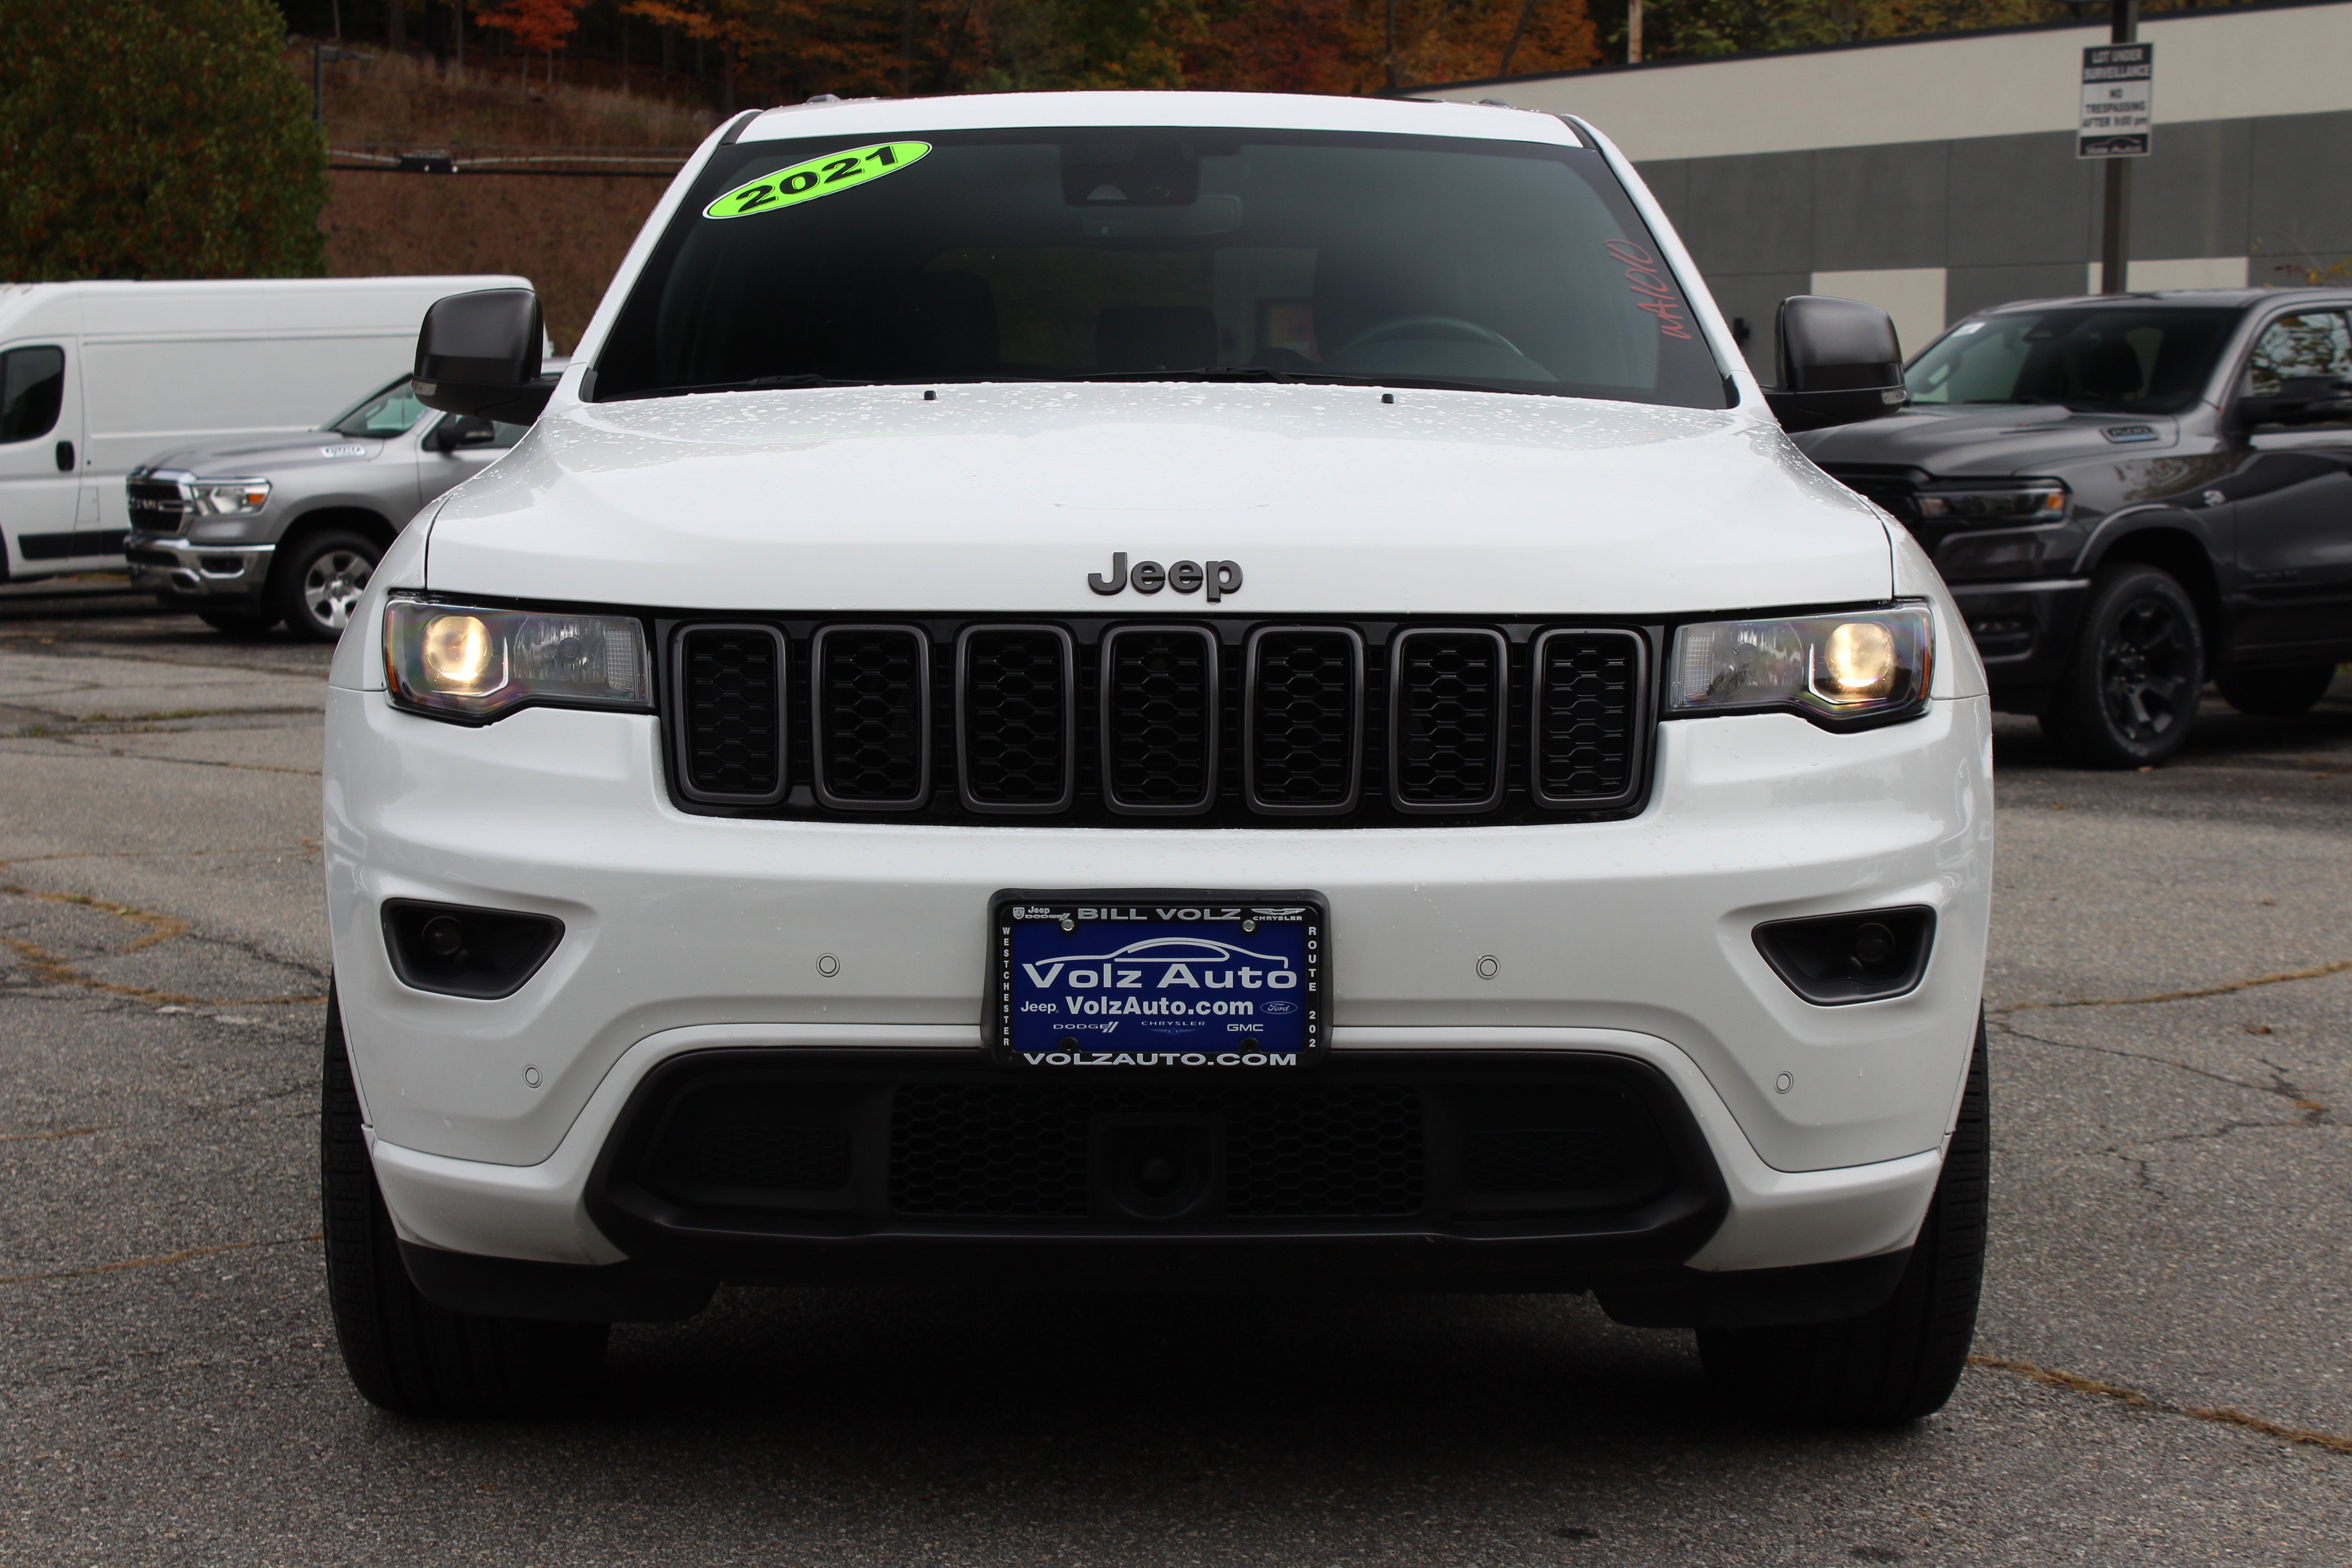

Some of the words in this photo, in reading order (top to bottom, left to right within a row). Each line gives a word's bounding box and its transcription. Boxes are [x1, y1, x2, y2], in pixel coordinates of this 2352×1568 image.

[2092, 50, 2110, 63] LOT
[2111, 49, 2143, 62] UNDER
[2083, 65, 2151, 79] SURVEILLANCE
[2110, 89, 2122, 98] NO
[2086, 102, 2146, 113] TRESPASSING
[2082, 117, 2110, 127] AFTER
[735, 145, 899, 214] 2021
[1088, 551, 1243, 603] Jeep
[1028, 906, 1050, 916] Jeep
[1078, 909, 1147, 920] BILL
[1156, 908, 1241, 920] VOLZ
[1308, 926, 1317, 992] ROUTE
[1021, 963, 1142, 989] Volz
[1156, 963, 1297, 989] Auto
[1002, 926, 1010, 1047] WESTCHESTER
[1021, 1001, 1057, 1014] Jeep
[1065, 996, 1254, 1015] VolzAuto.com
[1267, 1002, 1289, 1013] Ford
[1227, 1024, 1264, 1032] GMC
[1024, 1053, 1296, 1066] VOLZAUTO.COM
